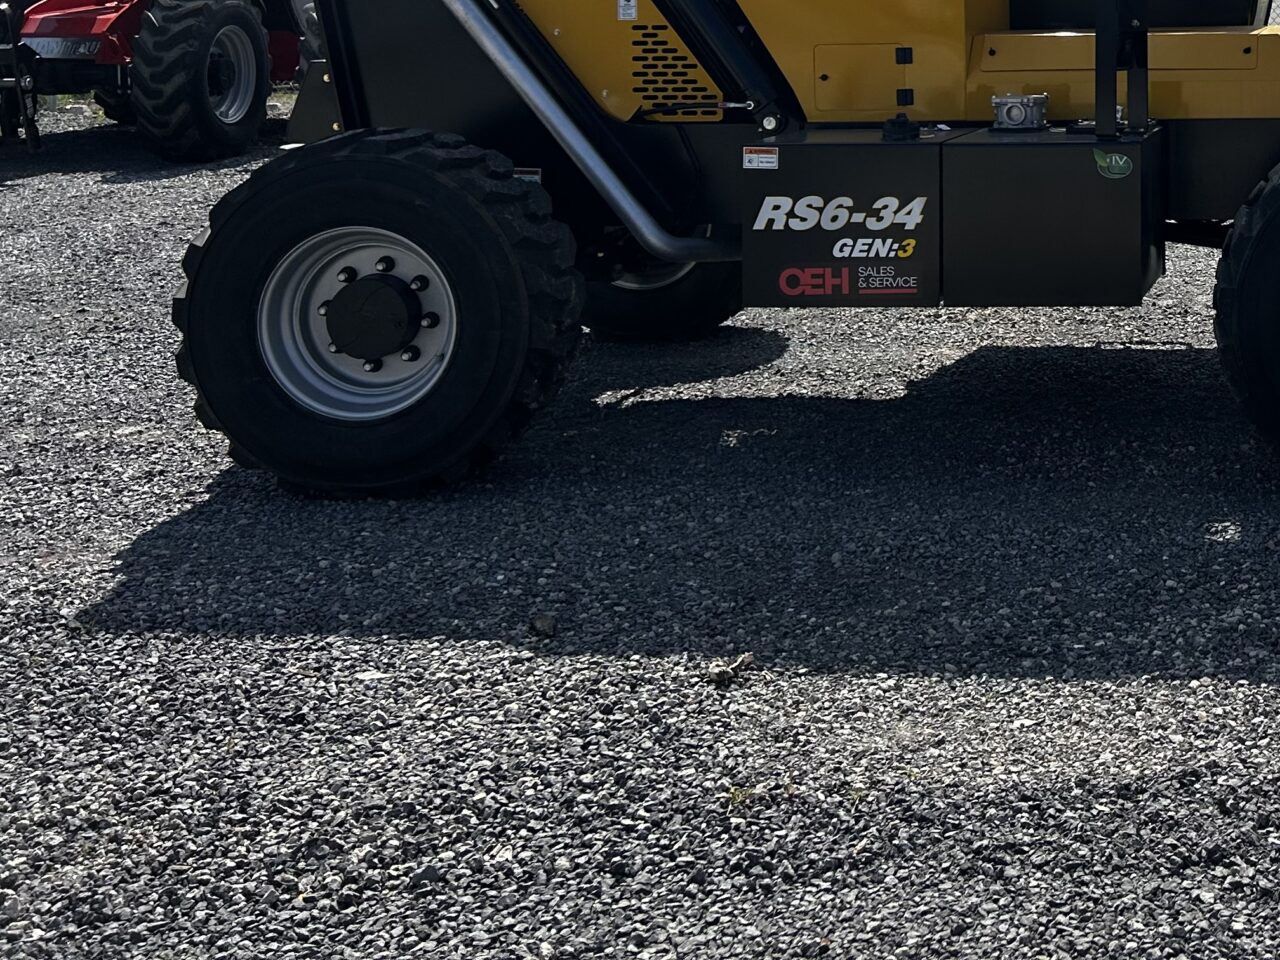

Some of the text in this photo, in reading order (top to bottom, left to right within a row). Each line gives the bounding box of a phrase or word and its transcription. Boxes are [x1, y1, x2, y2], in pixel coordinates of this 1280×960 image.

[752, 195, 928, 231] RS6-34
[832, 238, 917, 258] GEN:3
[779, 266, 849, 296] OEH
[858, 266, 895, 277] SALES
[858, 276, 918, 288] & SERVICE
